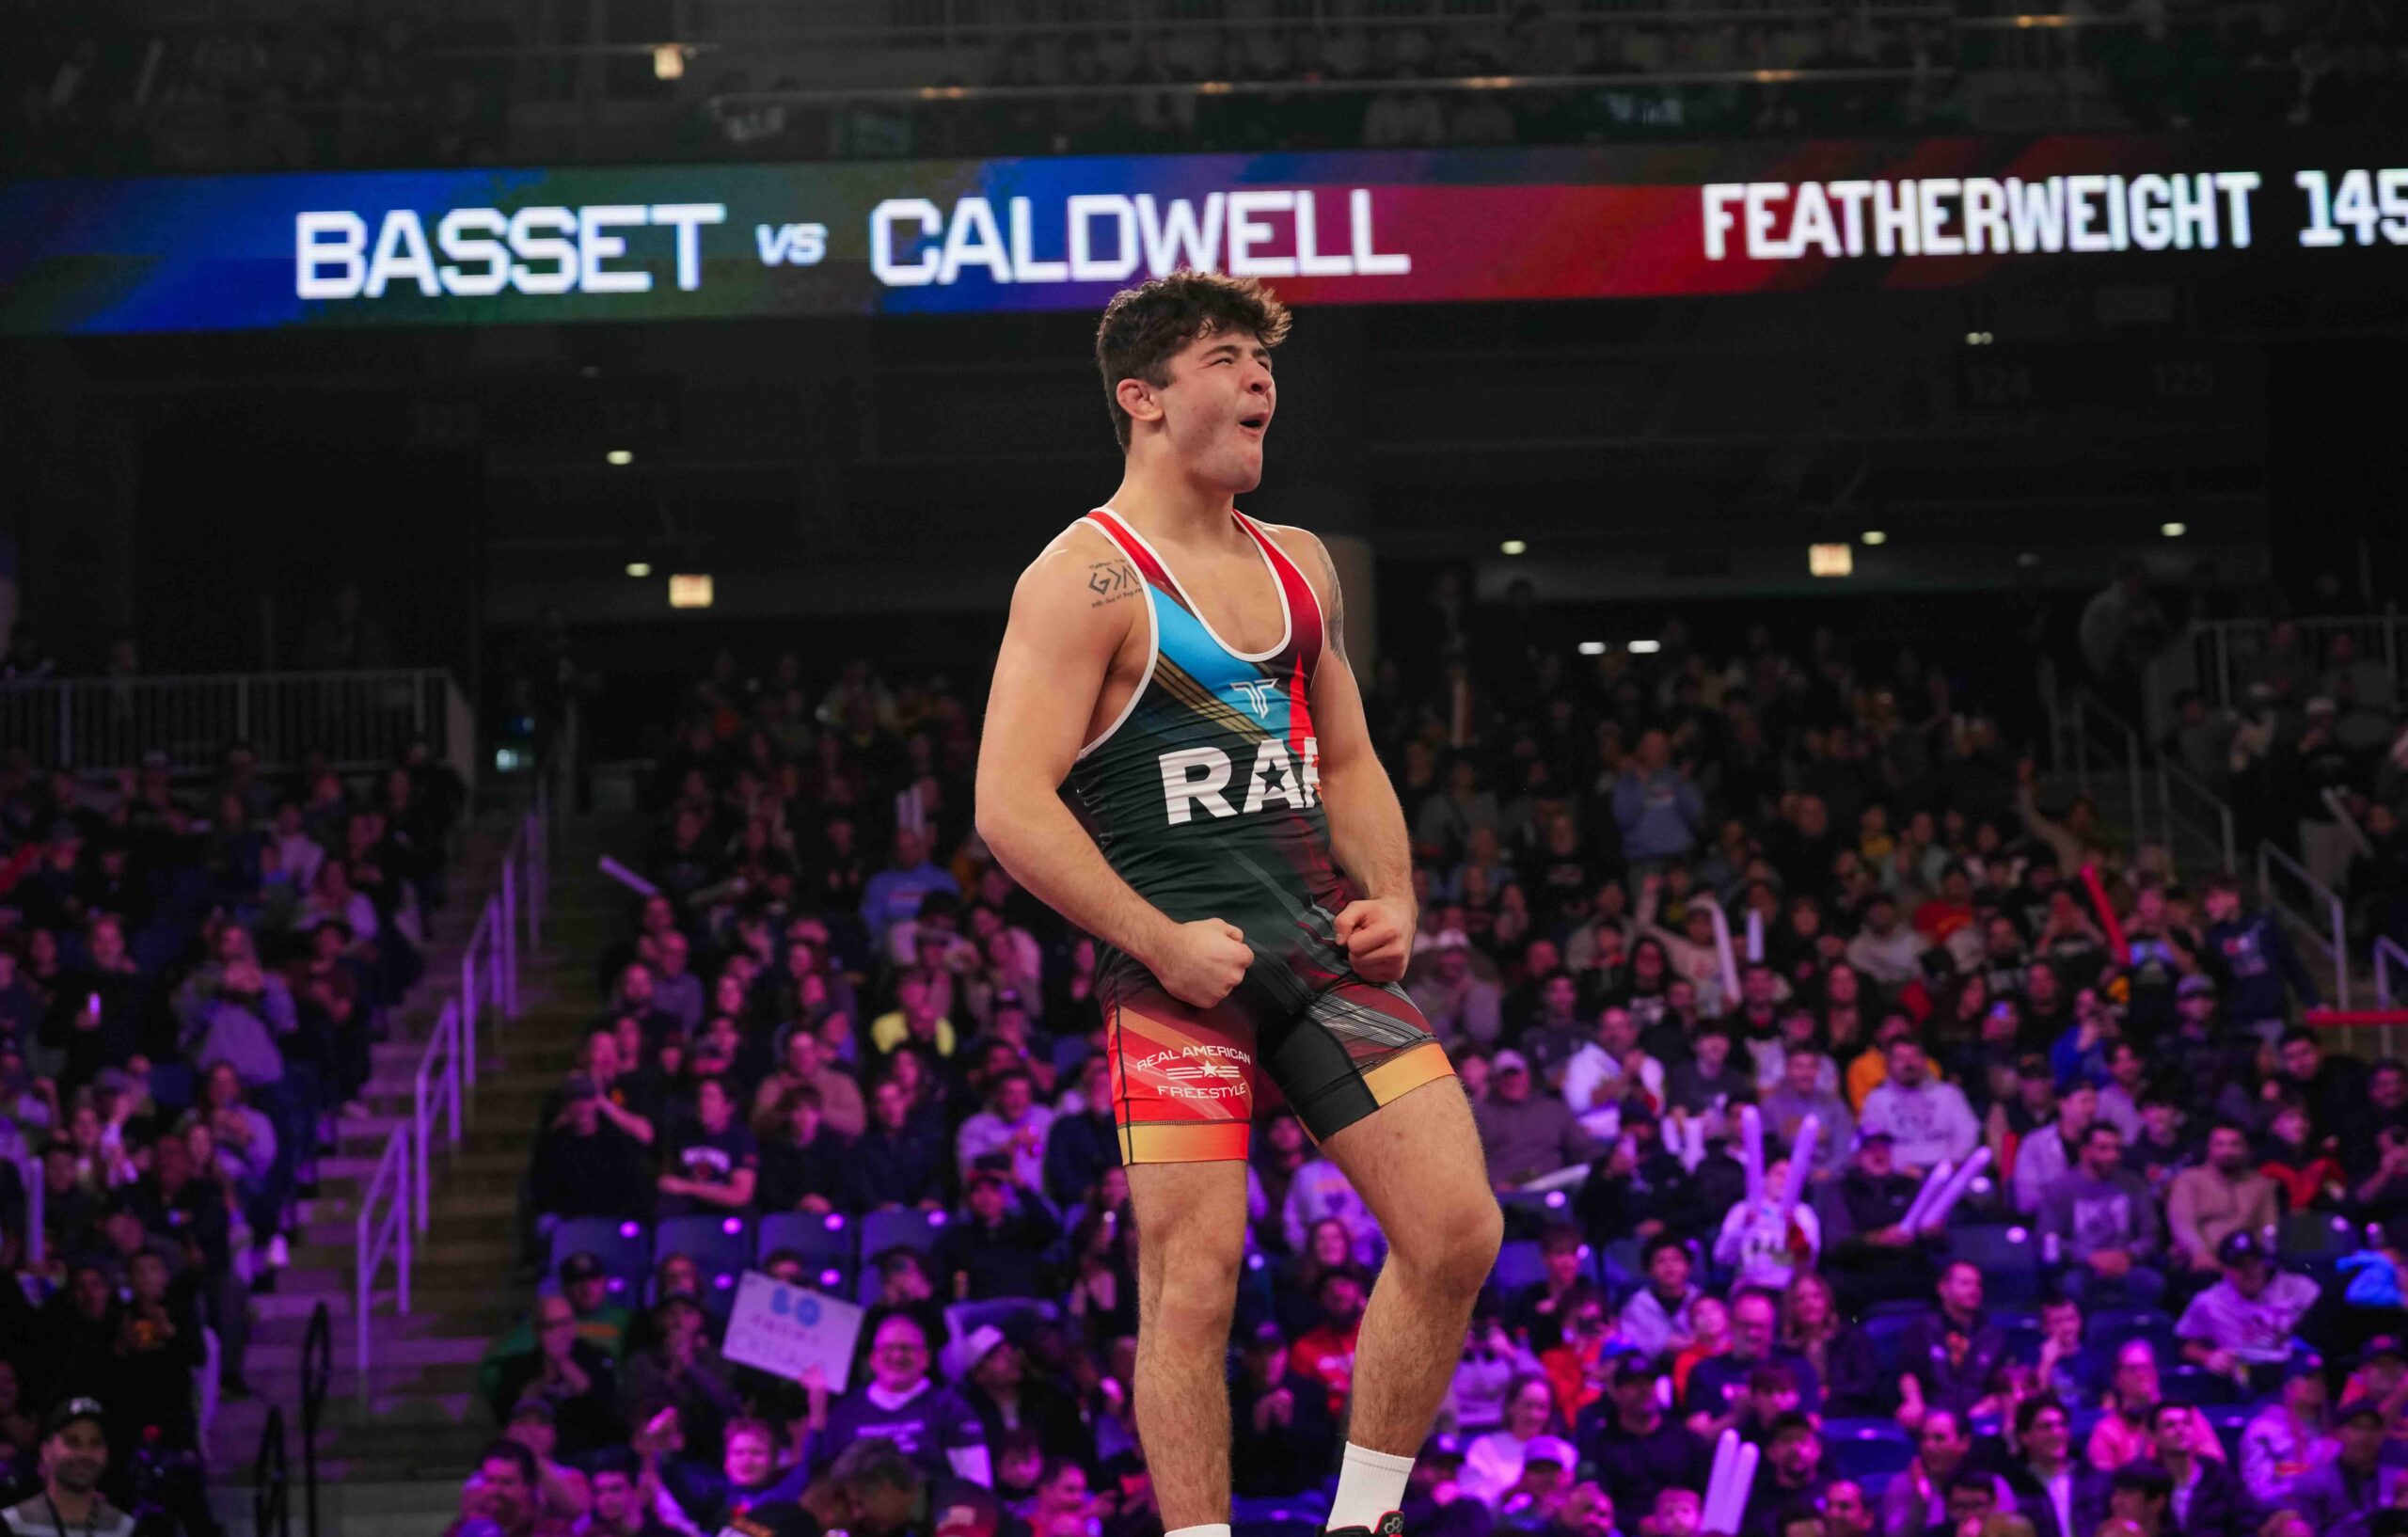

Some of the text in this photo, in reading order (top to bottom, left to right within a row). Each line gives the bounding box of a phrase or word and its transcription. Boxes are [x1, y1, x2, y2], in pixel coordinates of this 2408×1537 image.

[295, 202, 727, 299] BASSET
[870, 188, 1411, 287] CALDWELL
[1702, 167, 2408, 261] FEATHERWEIGHT 145
[1136, 1045, 1251, 1071] REAL AMERICAN
[1157, 1082, 1247, 1099] FREESTYLE
